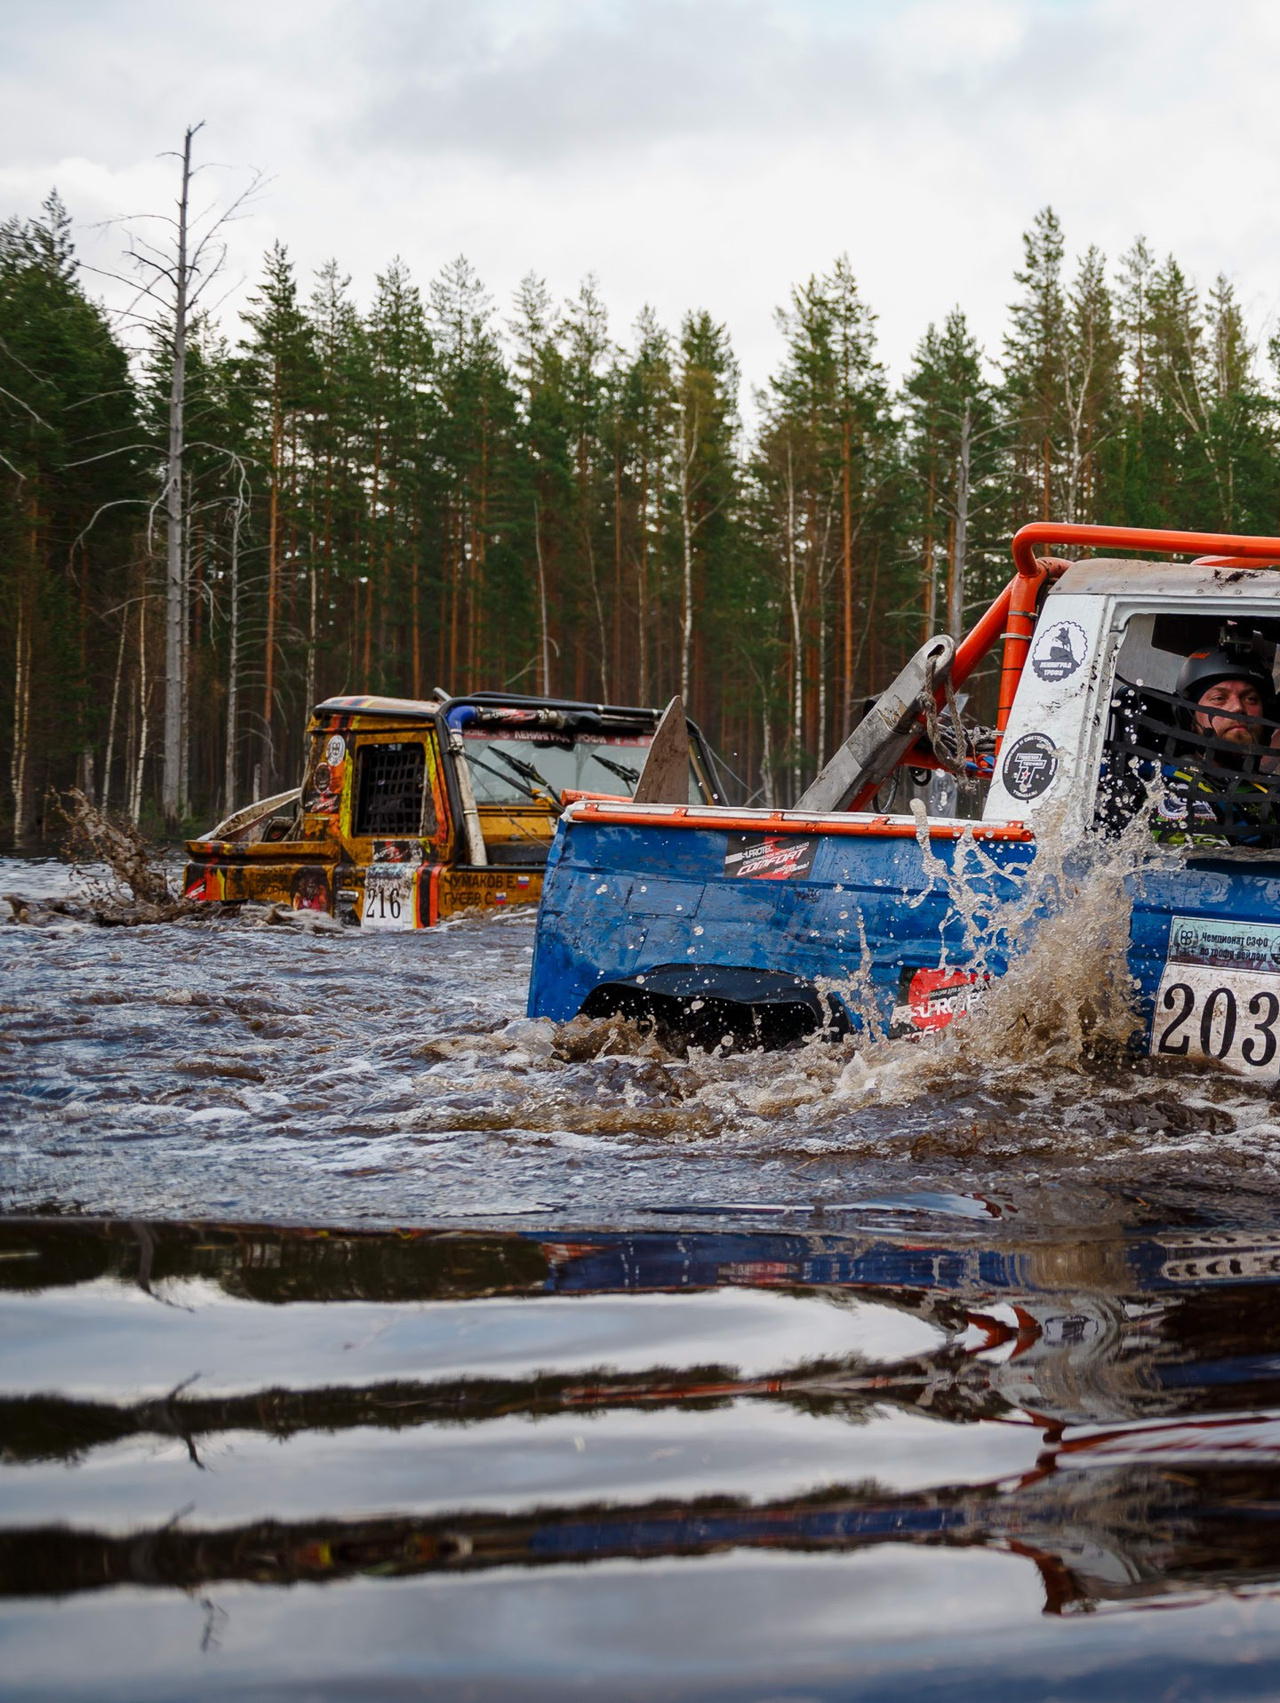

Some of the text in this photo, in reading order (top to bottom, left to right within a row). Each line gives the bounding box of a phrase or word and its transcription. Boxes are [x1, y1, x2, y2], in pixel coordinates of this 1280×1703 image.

[742, 844, 774, 859] SUPROTEC
[736, 847, 808, 876] COMFORT
[444, 876, 504, 889] ЧУМАКОВ
[366, 888, 401, 919] 216
[443, 892, 482, 906] ГУСЕВ
[1201, 932, 1269, 948] Чемпионат СЗФО
[1158, 982, 1280, 1067] 203
